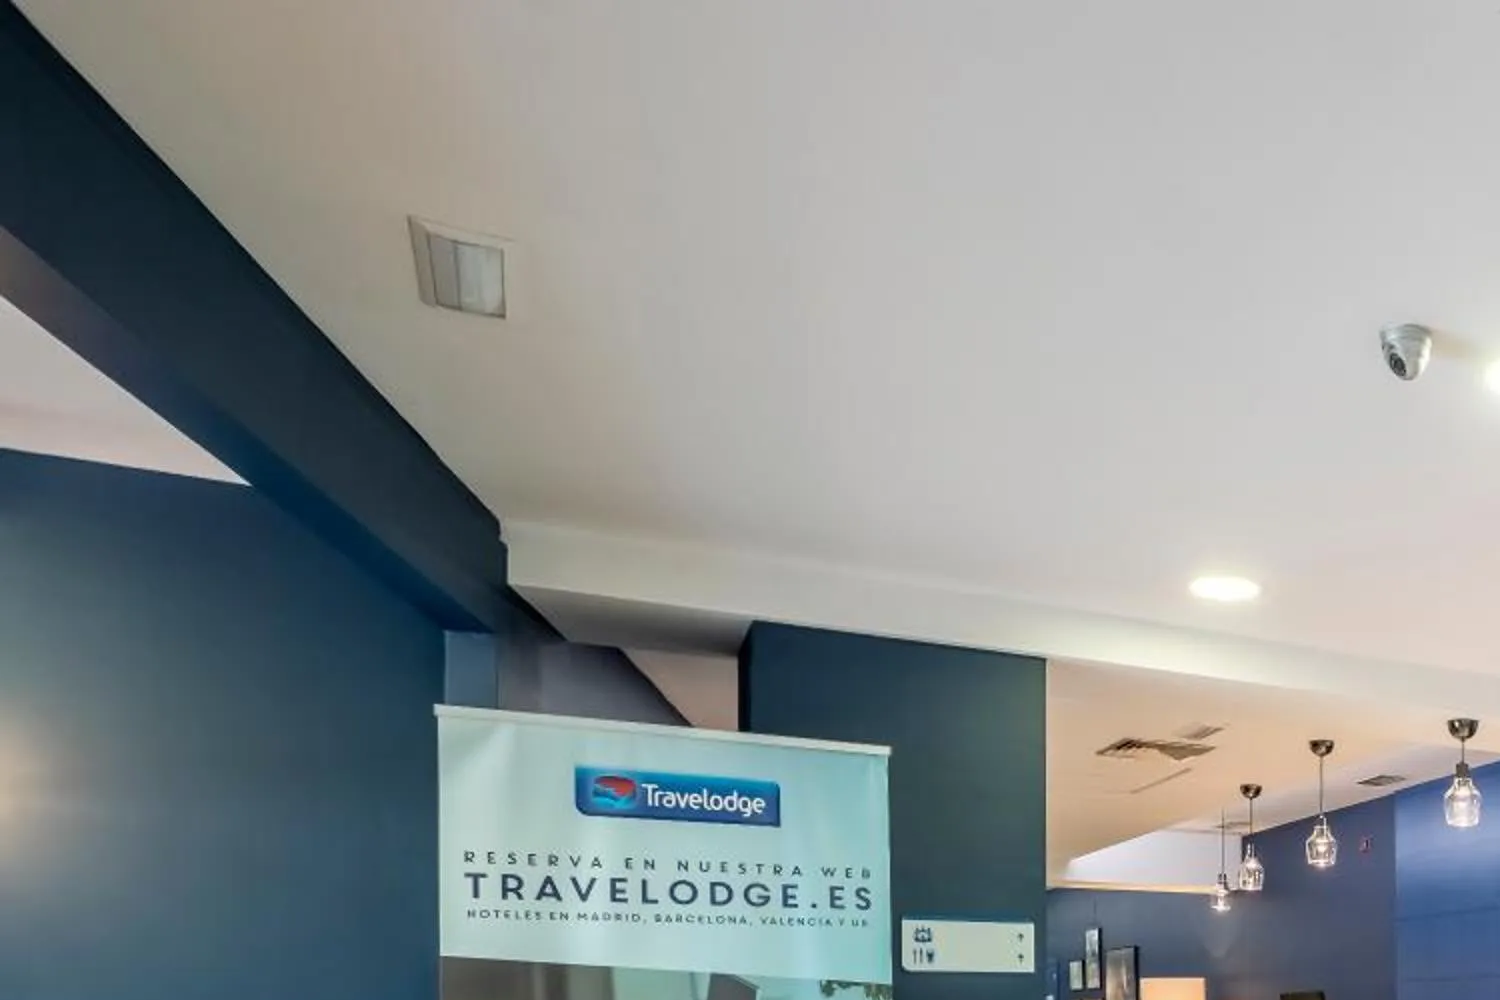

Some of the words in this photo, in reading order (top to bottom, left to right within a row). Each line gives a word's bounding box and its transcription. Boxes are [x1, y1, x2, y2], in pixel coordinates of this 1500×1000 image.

[642, 782, 767, 817] Travelodge
[464, 851, 603, 868] RESERVA
[625, 857, 656, 870] EN
[677, 860, 803, 877] NUESTRA
[821, 866, 871, 879] WEB
[464, 872, 872, 911] TRAVELODGE.ES
[467, 908, 542, 921] HOTELES
[549, 911, 569, 921] EN
[577, 912, 648, 925] MADRID,
[654, 913, 753, 927] BARCELONA,
[760, 916, 832, 927] VALENCIA
